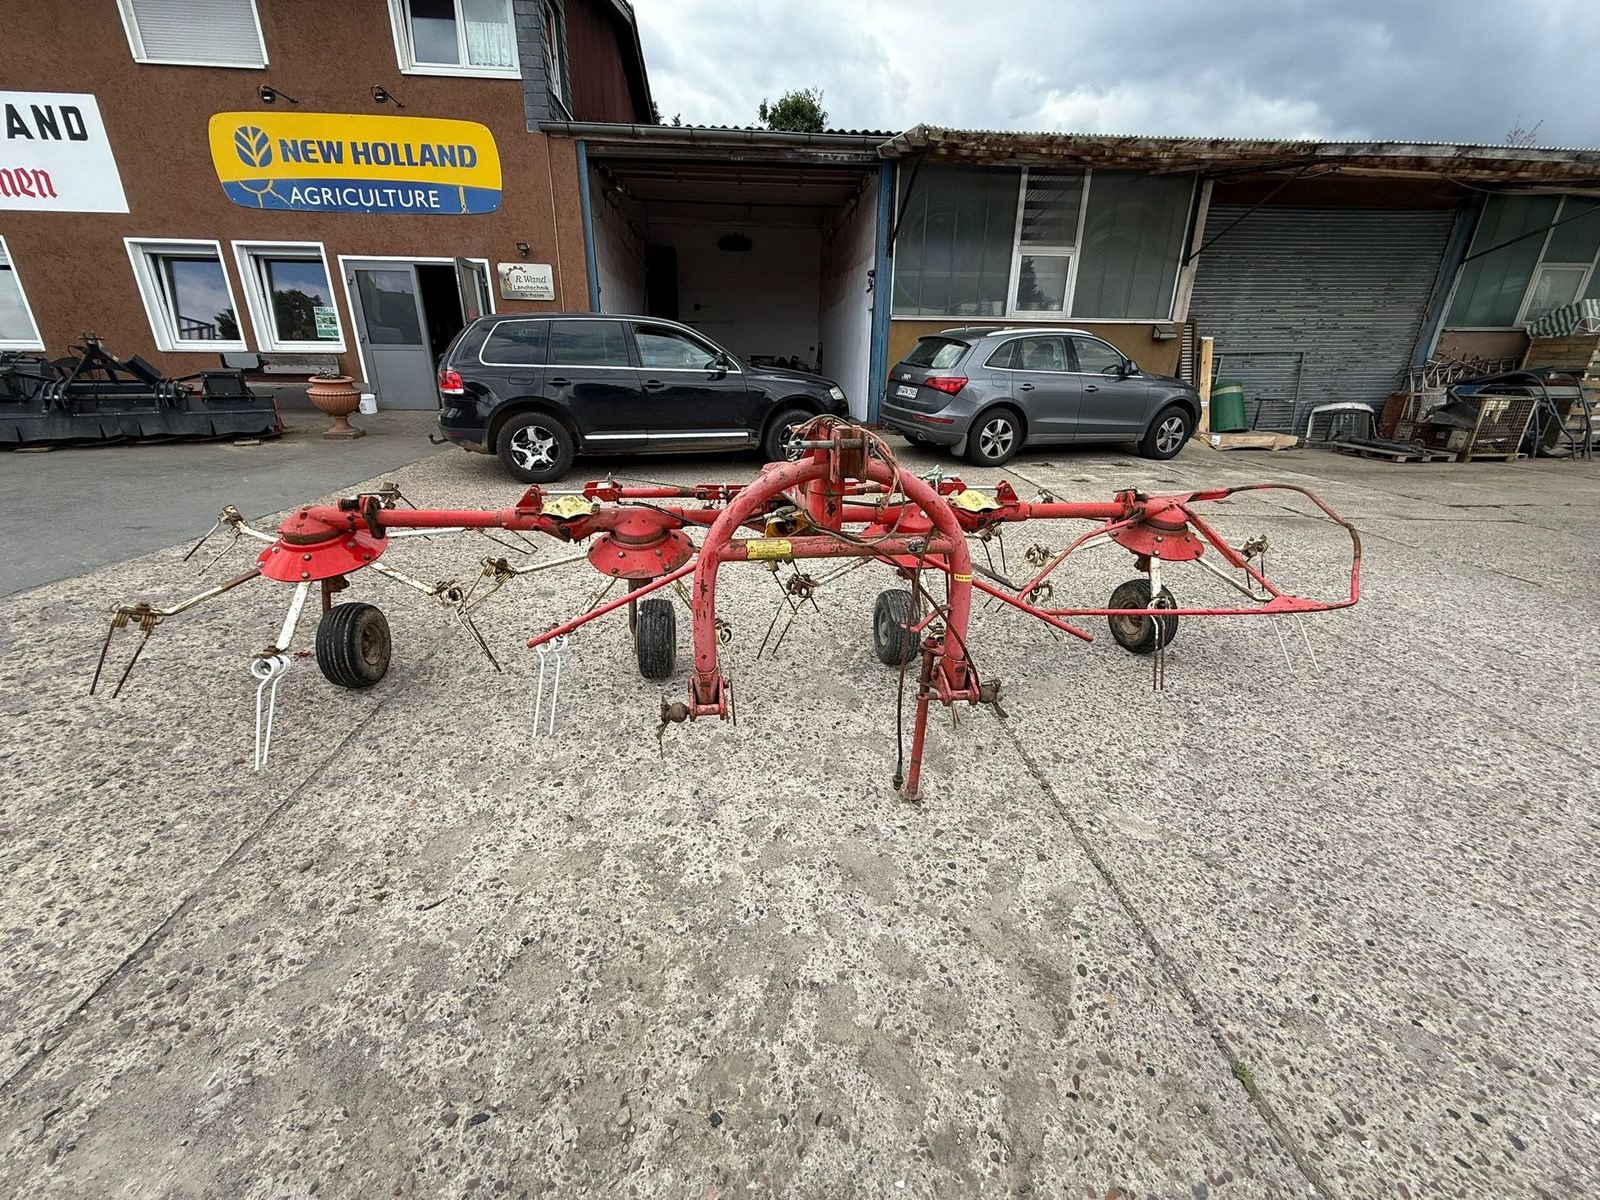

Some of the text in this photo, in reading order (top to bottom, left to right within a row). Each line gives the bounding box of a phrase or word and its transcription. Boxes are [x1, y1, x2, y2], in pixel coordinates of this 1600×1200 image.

[5, 103, 88, 141] AND
[279, 139, 477, 168] NEW HOLLAND
[290, 186, 441, 209] AGRICULTURE
